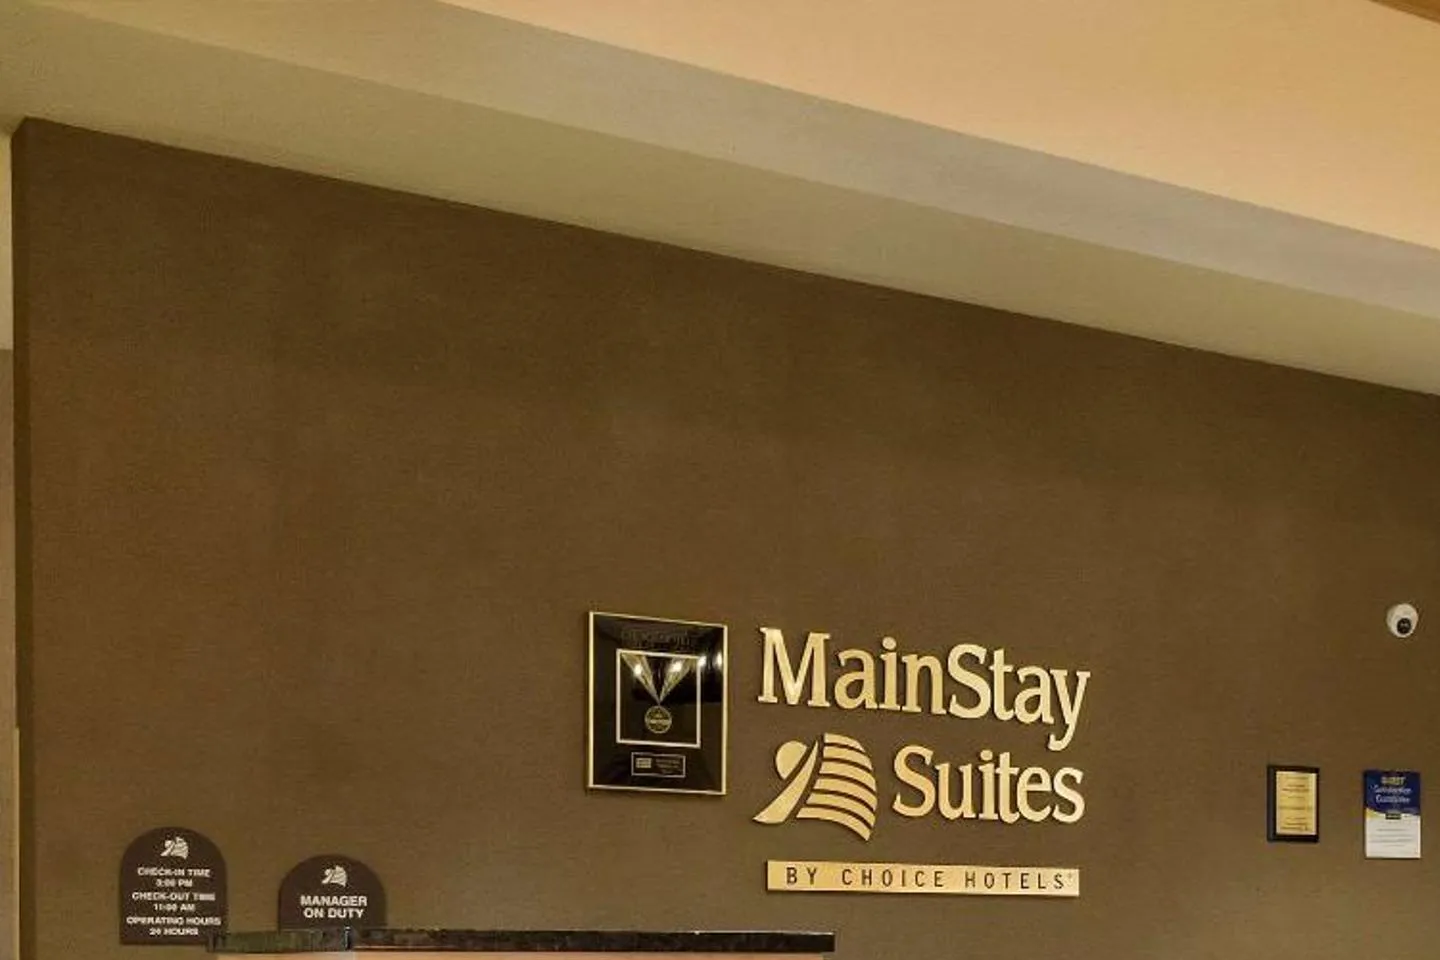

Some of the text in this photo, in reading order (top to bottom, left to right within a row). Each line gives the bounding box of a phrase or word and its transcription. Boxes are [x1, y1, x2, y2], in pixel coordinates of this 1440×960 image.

[758, 626, 1092, 751] MainStay
[892, 744, 1086, 825] Suites
[178, 878, 193, 887] PM
[786, 866, 818, 885] BY
[841, 868, 945, 888] CHOICE
[300, 895, 368, 907] MANAGER
[303, 907, 364, 919] ON DUTY
